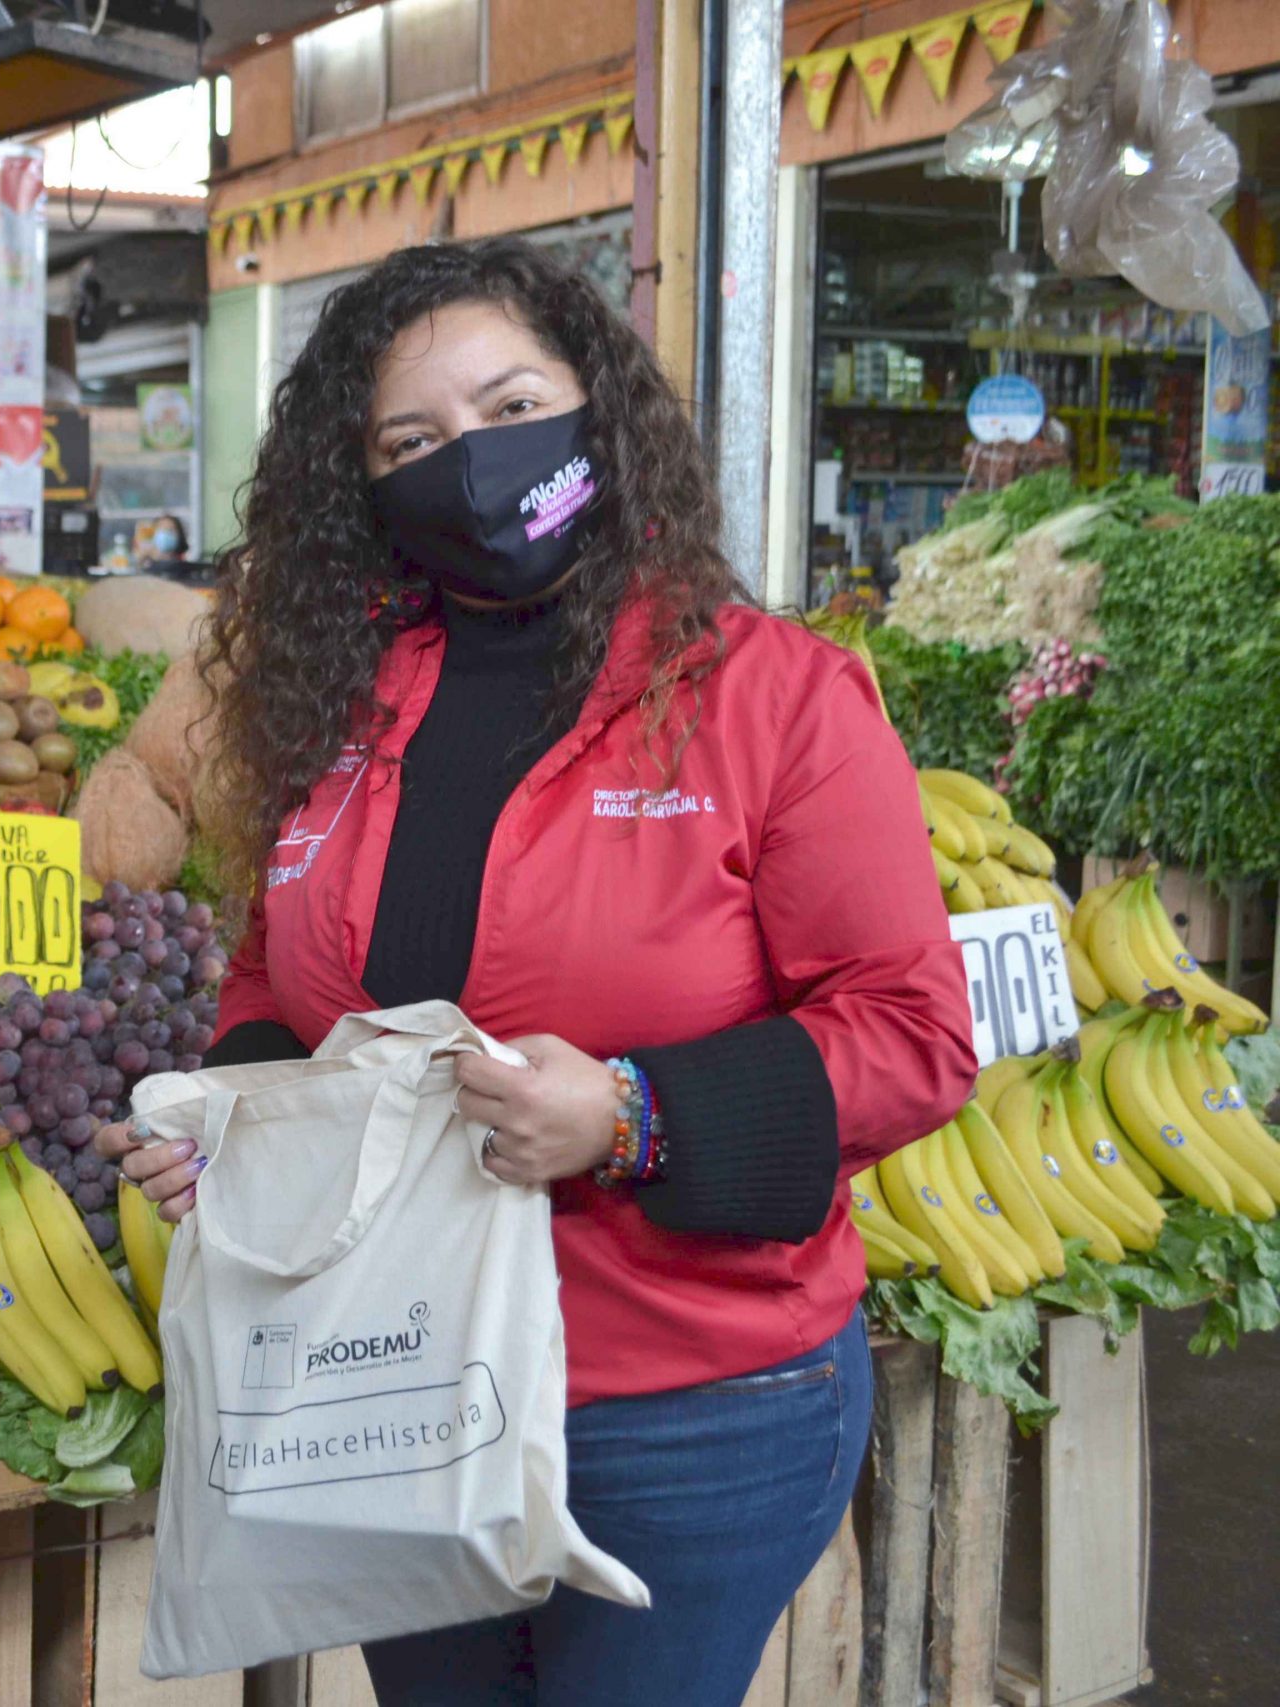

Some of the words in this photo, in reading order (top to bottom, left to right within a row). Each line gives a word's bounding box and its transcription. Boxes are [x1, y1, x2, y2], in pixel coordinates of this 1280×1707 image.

[519, 456, 590, 514] #NoMás
[642, 795, 700, 819] CARVAJAL
[704, 796, 716, 812] C.
[307, 1329, 421, 1373] PRODEMU
